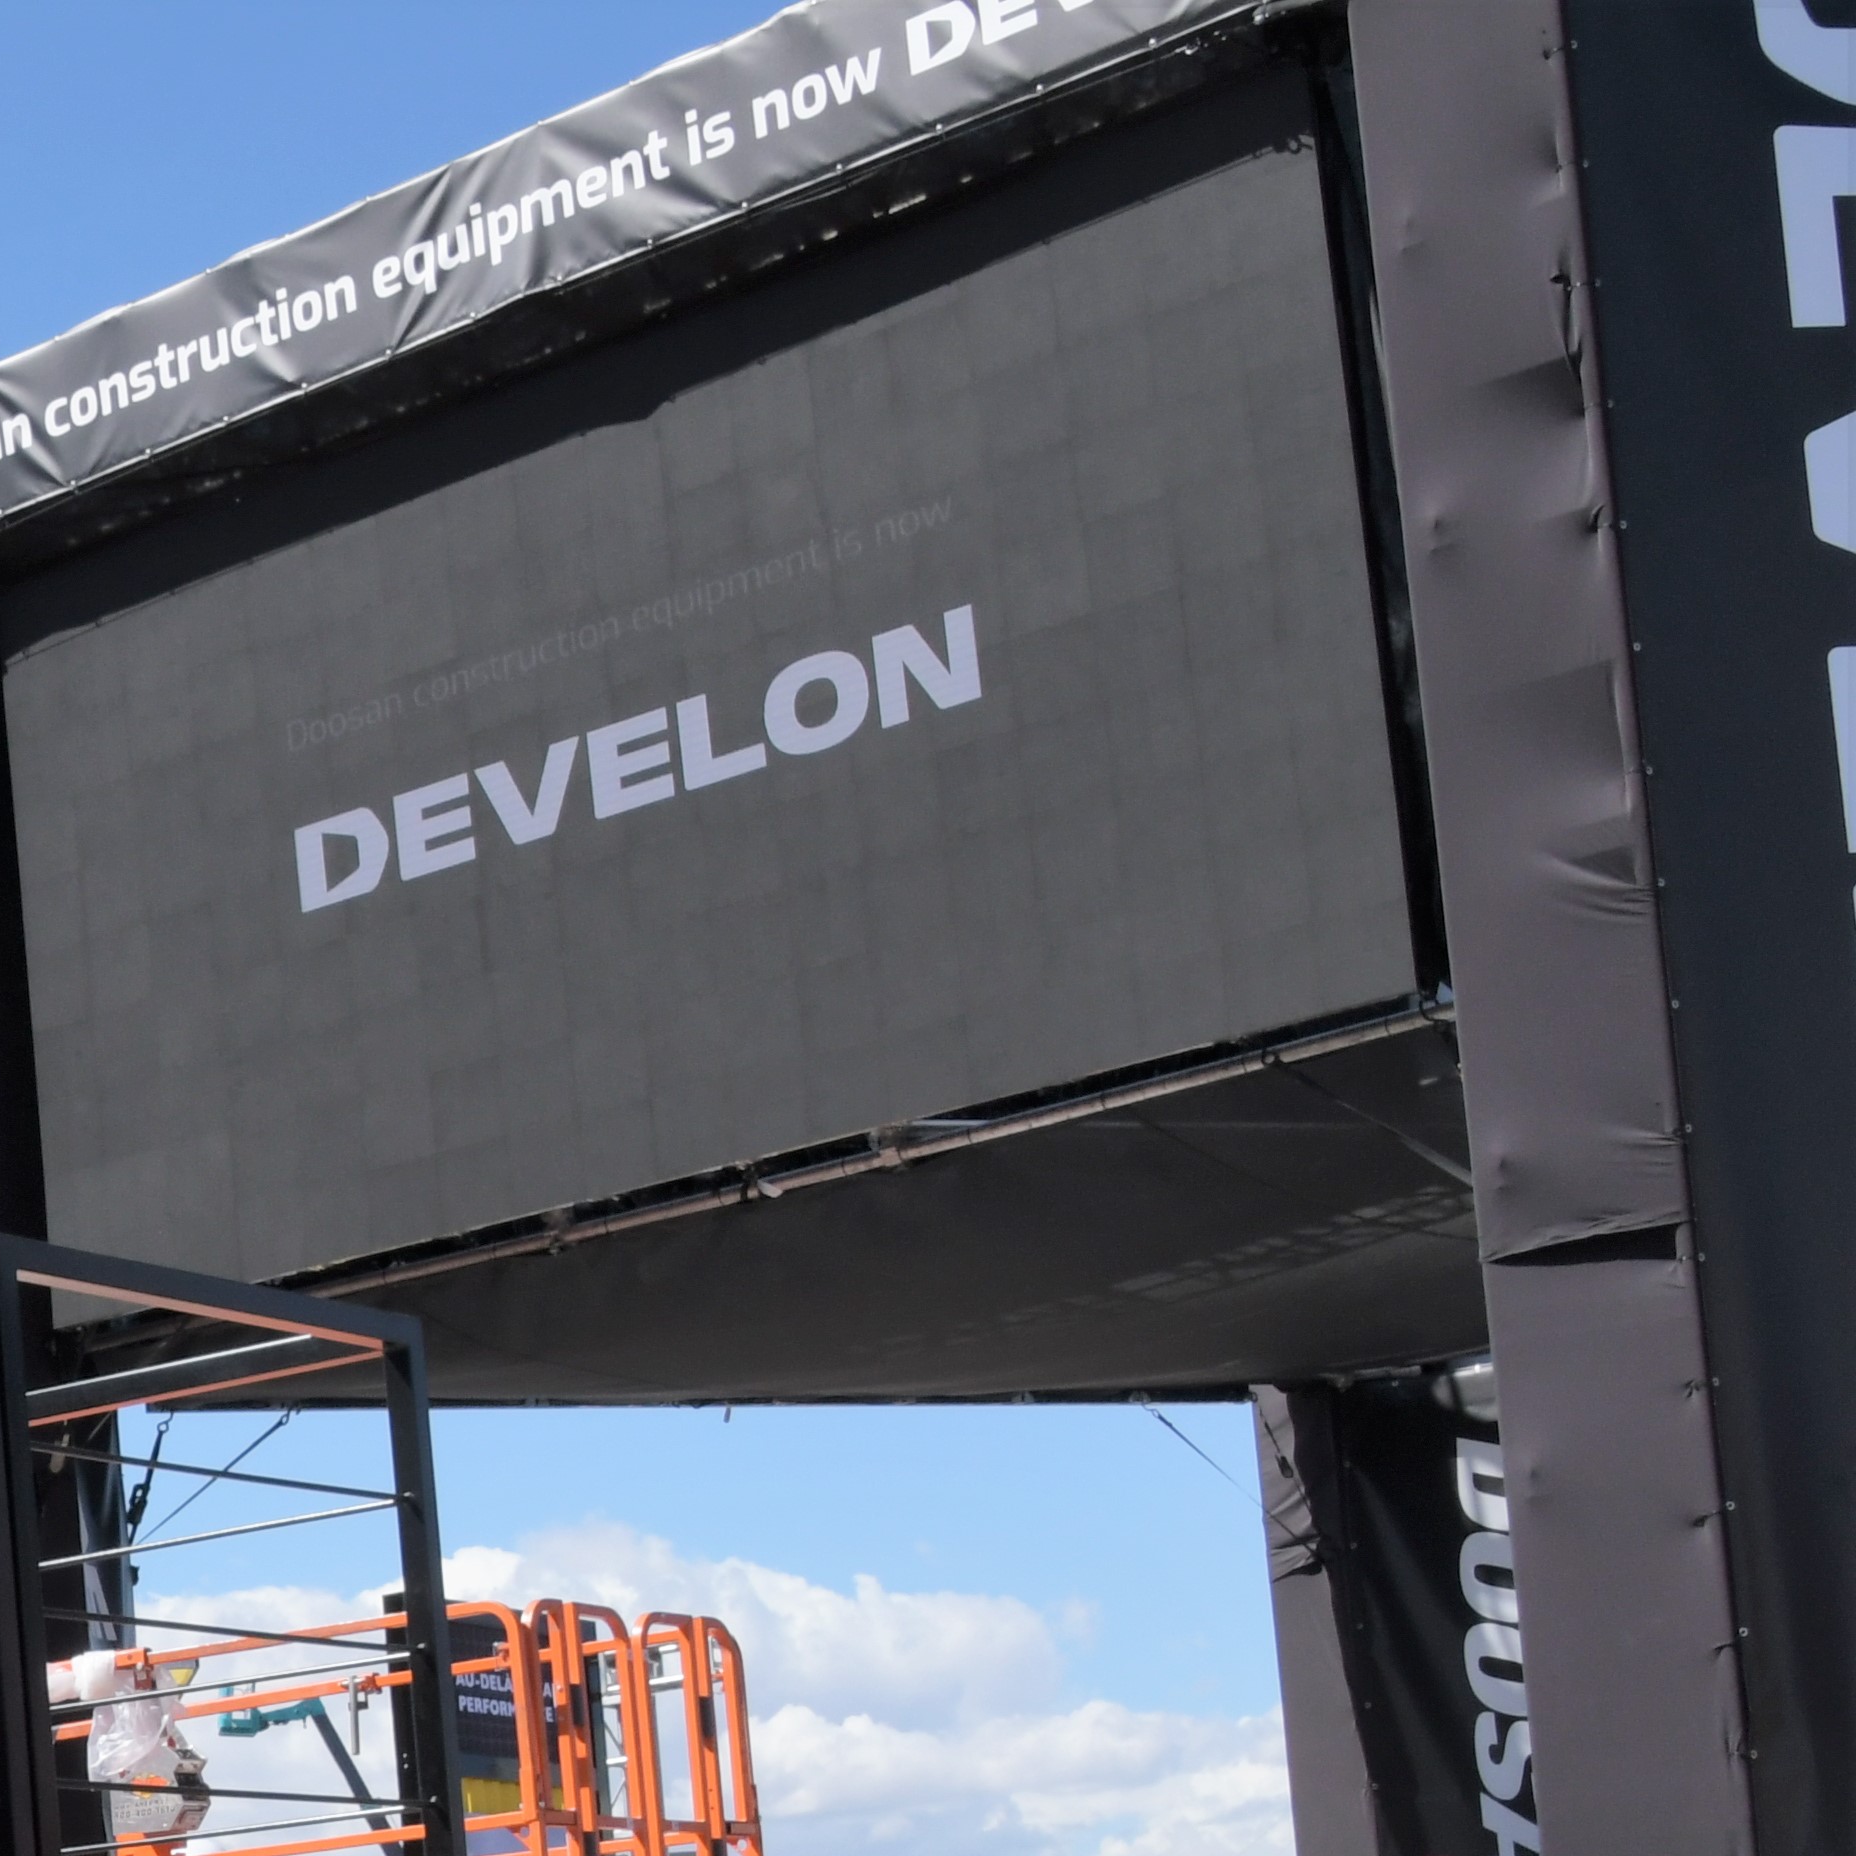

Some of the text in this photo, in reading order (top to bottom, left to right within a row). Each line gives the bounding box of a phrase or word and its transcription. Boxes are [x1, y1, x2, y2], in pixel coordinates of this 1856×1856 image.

[43, 274, 357, 438] construction
[372, 127, 670, 295] equipment
[684, 109, 735, 166] is
[751, 47, 882, 139] now
[905, 0, 1092, 76] DE
[286, 689, 404, 755] Doosan
[412, 613, 621, 708] construction
[632, 538, 819, 631] equipment
[874, 496, 952, 547] now
[294, 603, 983, 914] DEVELON
